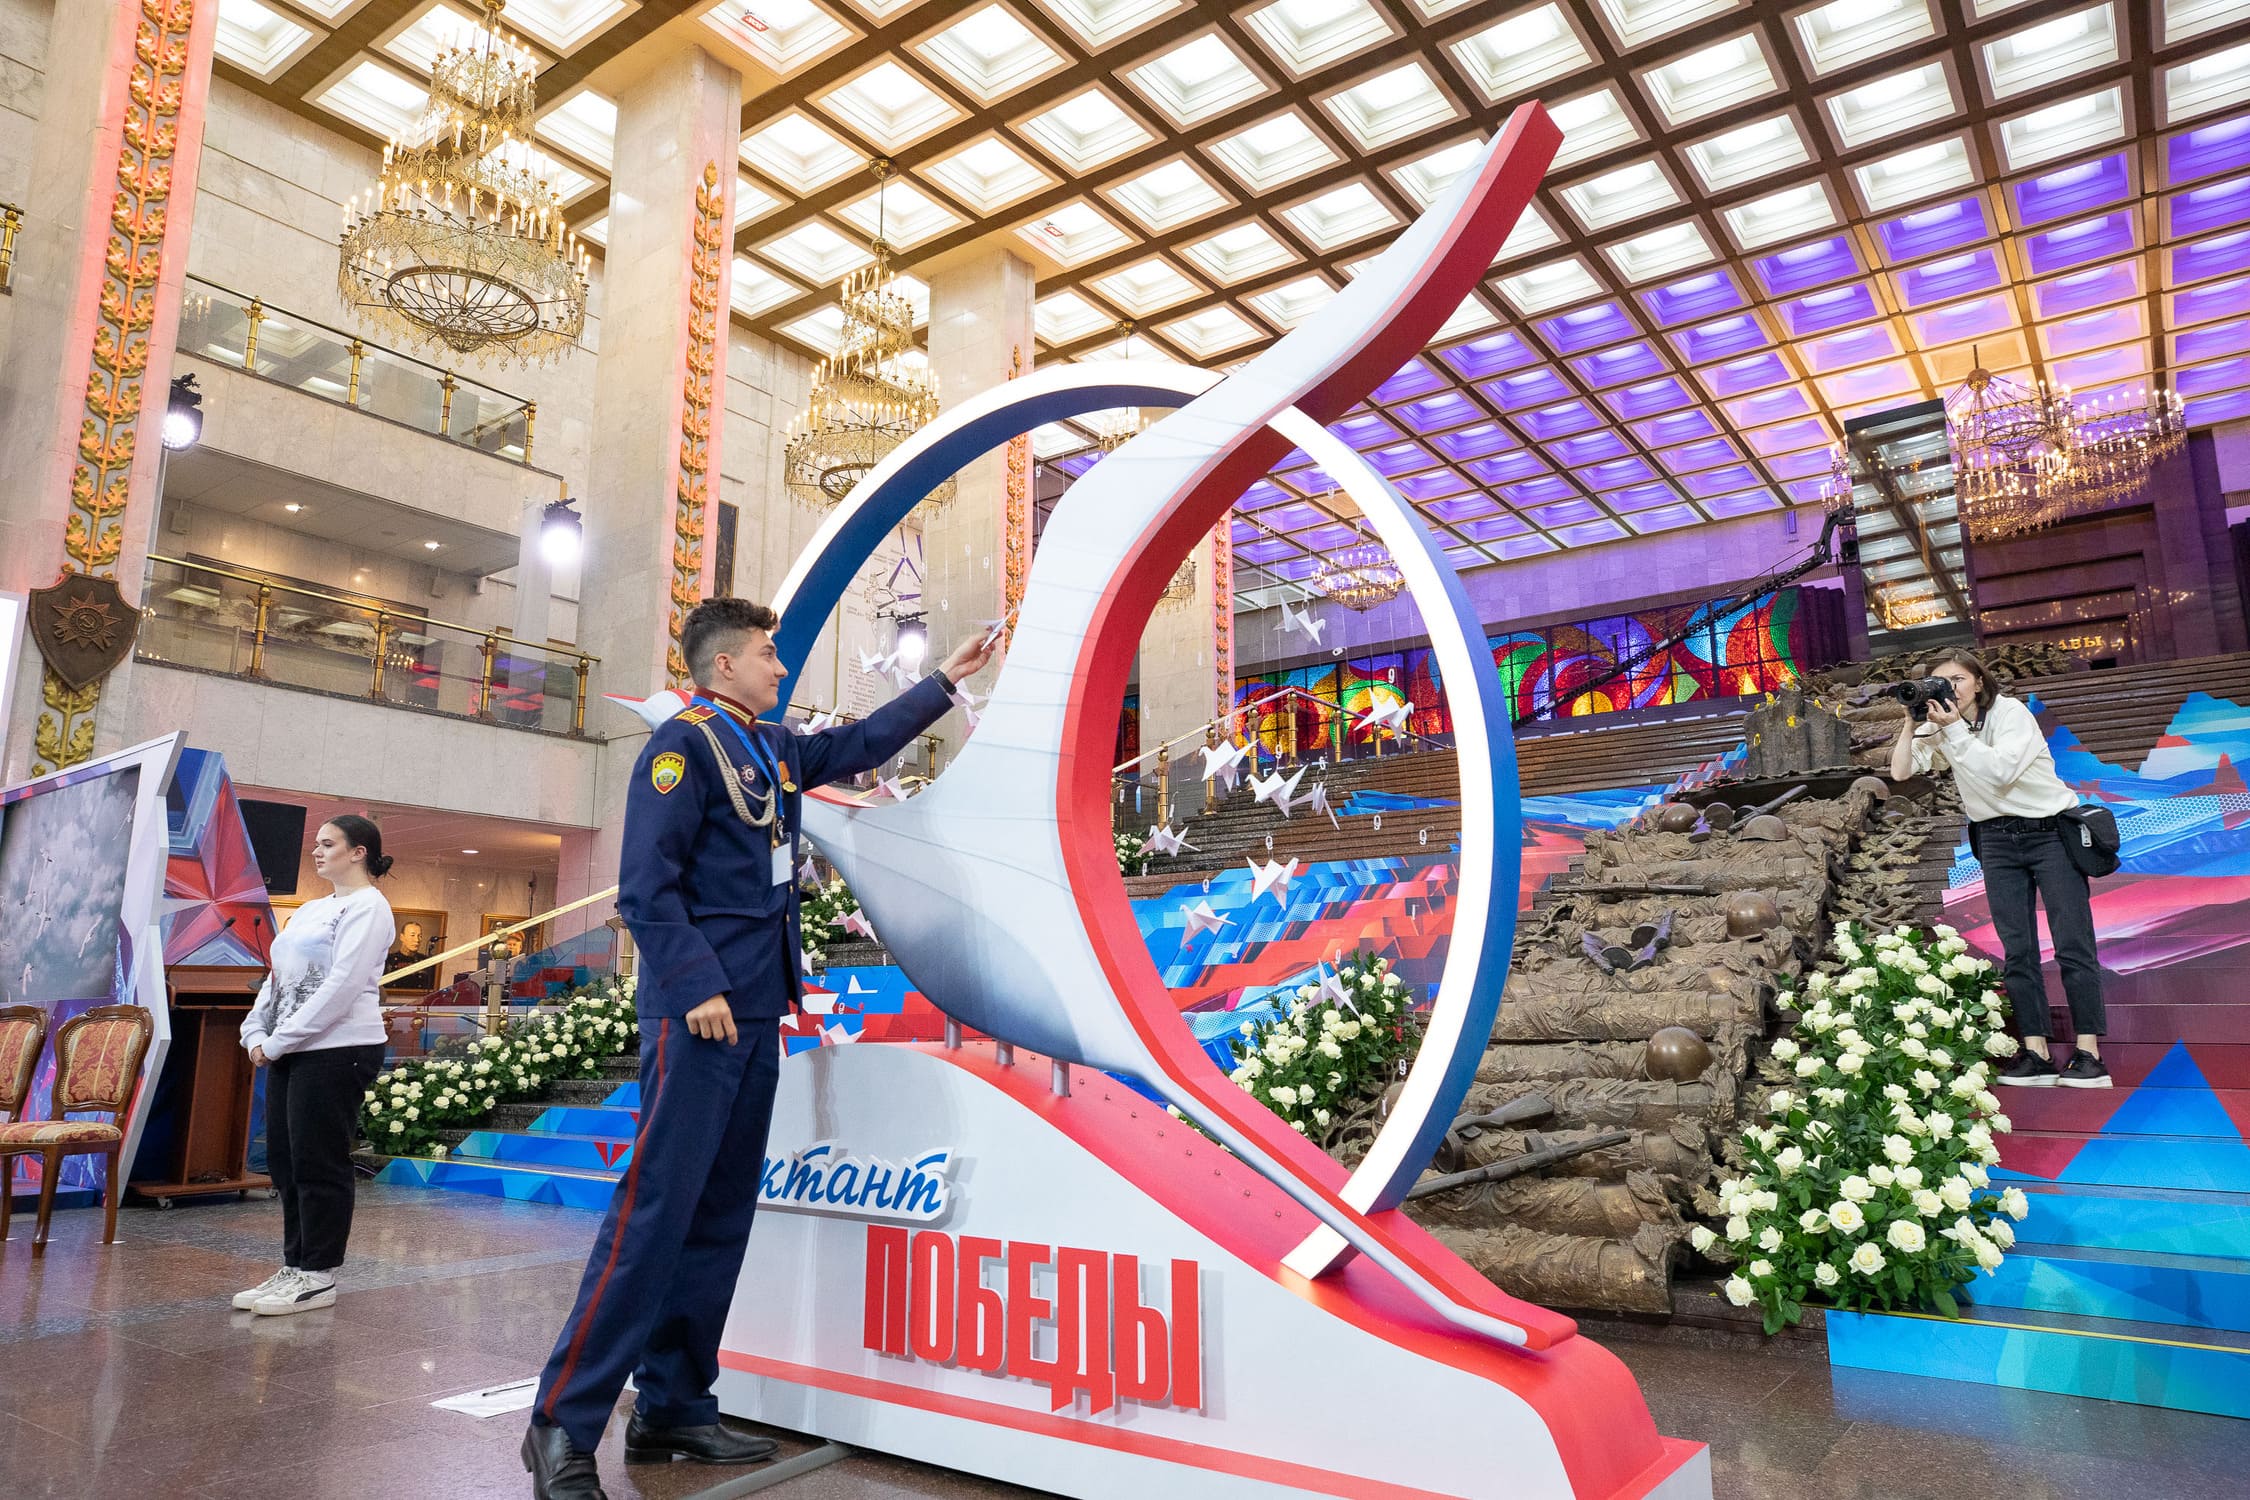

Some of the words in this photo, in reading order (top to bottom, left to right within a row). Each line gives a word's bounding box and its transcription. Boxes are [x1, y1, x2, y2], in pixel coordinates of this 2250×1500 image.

[2058, 636, 2102, 651] АВЫ
[1388, 668, 1395, 684] 9
[1275, 743, 1283, 759] 9
[758, 1145, 948, 1214] ктант
[864, 1224, 1201, 1416] ПОБЕДЫ
